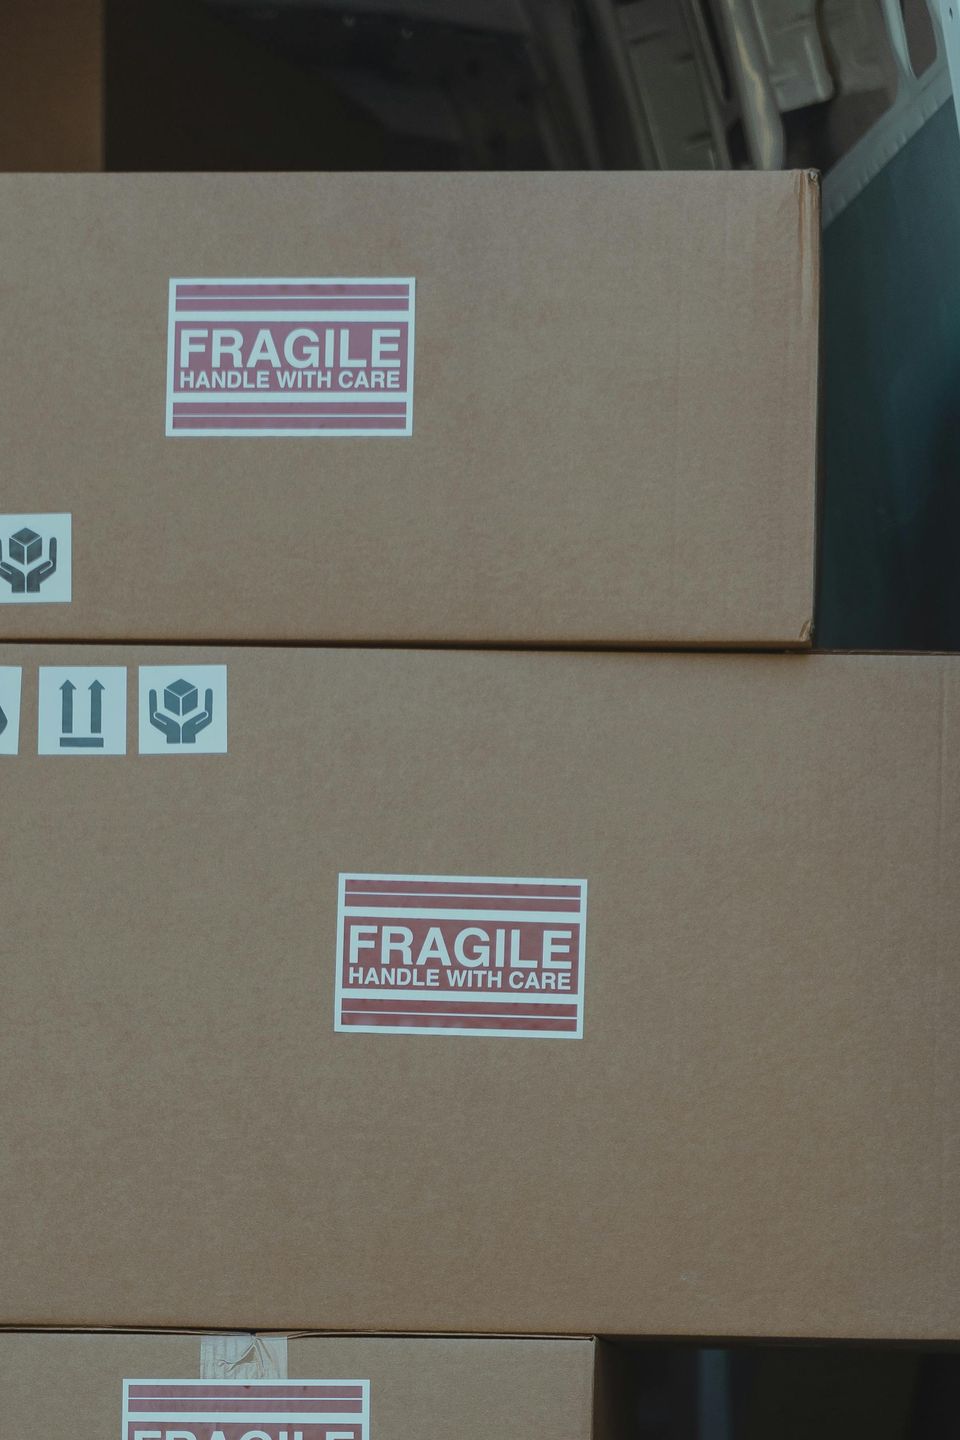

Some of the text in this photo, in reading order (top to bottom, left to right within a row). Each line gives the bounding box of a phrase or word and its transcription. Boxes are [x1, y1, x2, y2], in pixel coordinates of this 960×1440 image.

[179, 328, 401, 369] FRAGILE
[179, 371, 401, 389] HANDLE WITH CARE
[348, 924, 573, 970] FRAGILE
[348, 966, 572, 991] HANDLE WITH CARE
